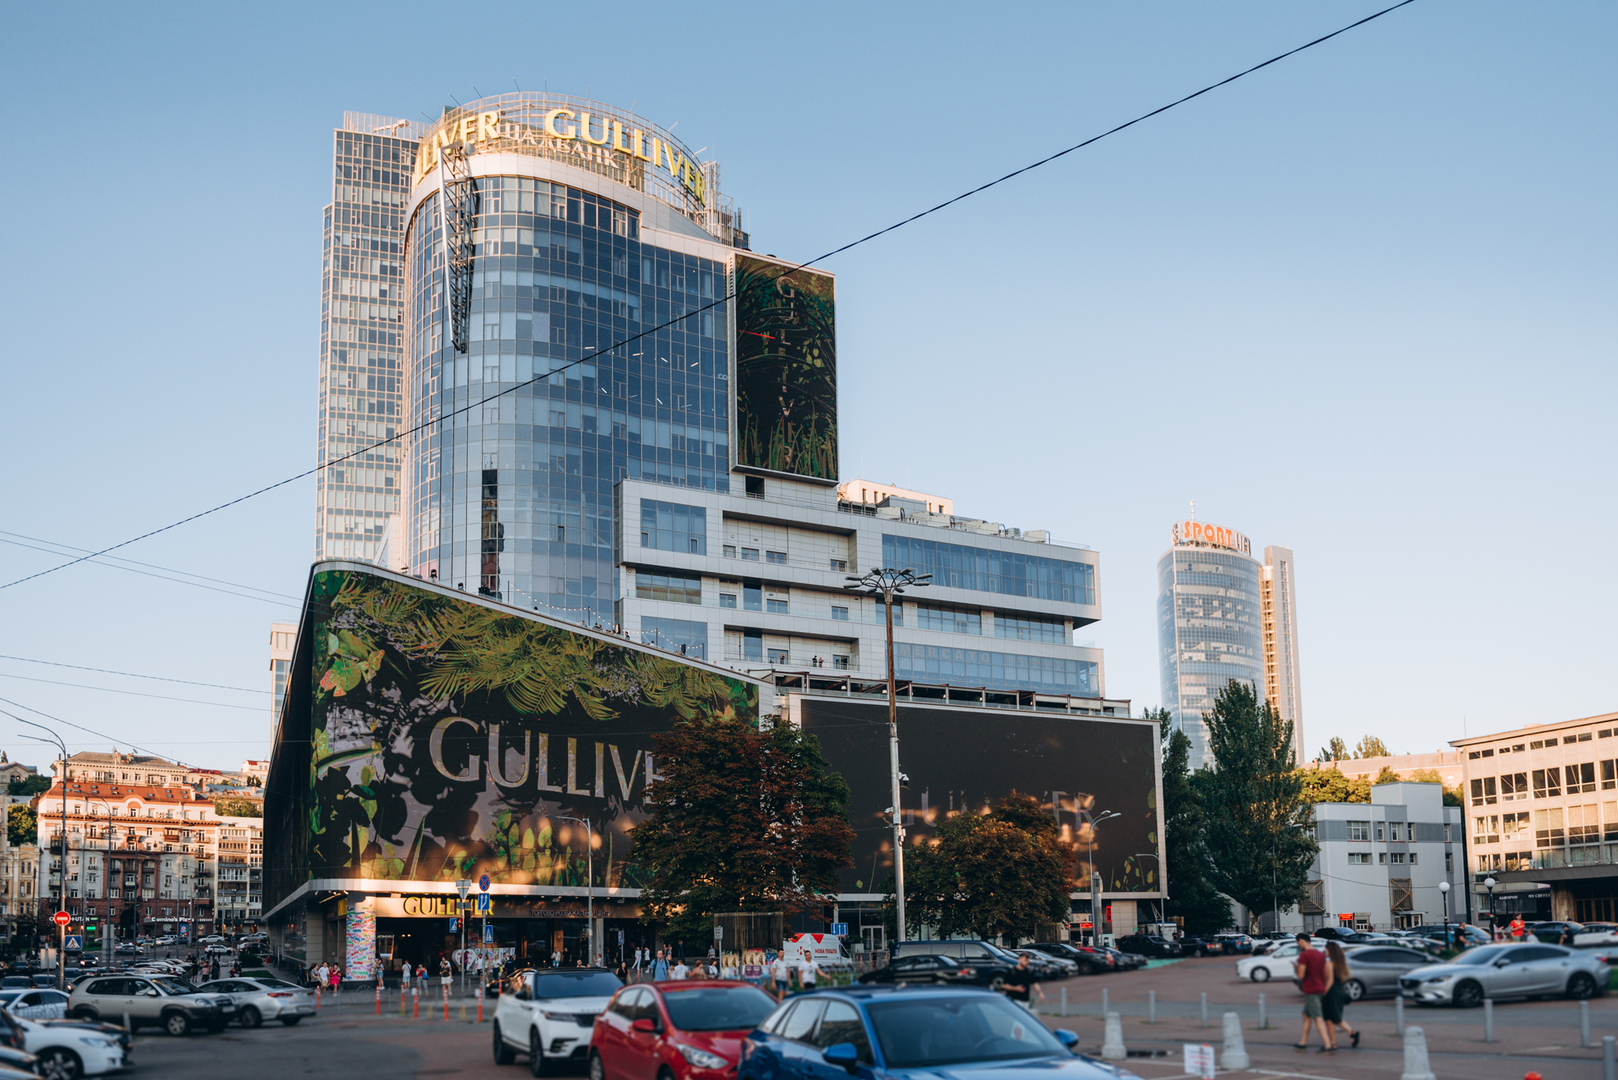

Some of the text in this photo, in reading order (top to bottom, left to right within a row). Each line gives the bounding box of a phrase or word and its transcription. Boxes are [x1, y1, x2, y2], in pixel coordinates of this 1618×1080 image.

[411, 111, 500, 192] LLIVER
[545, 108, 706, 208] GULLIVER
[1183, 521, 1233, 547] SPORT
[429, 716, 676, 805] GULLIVE
